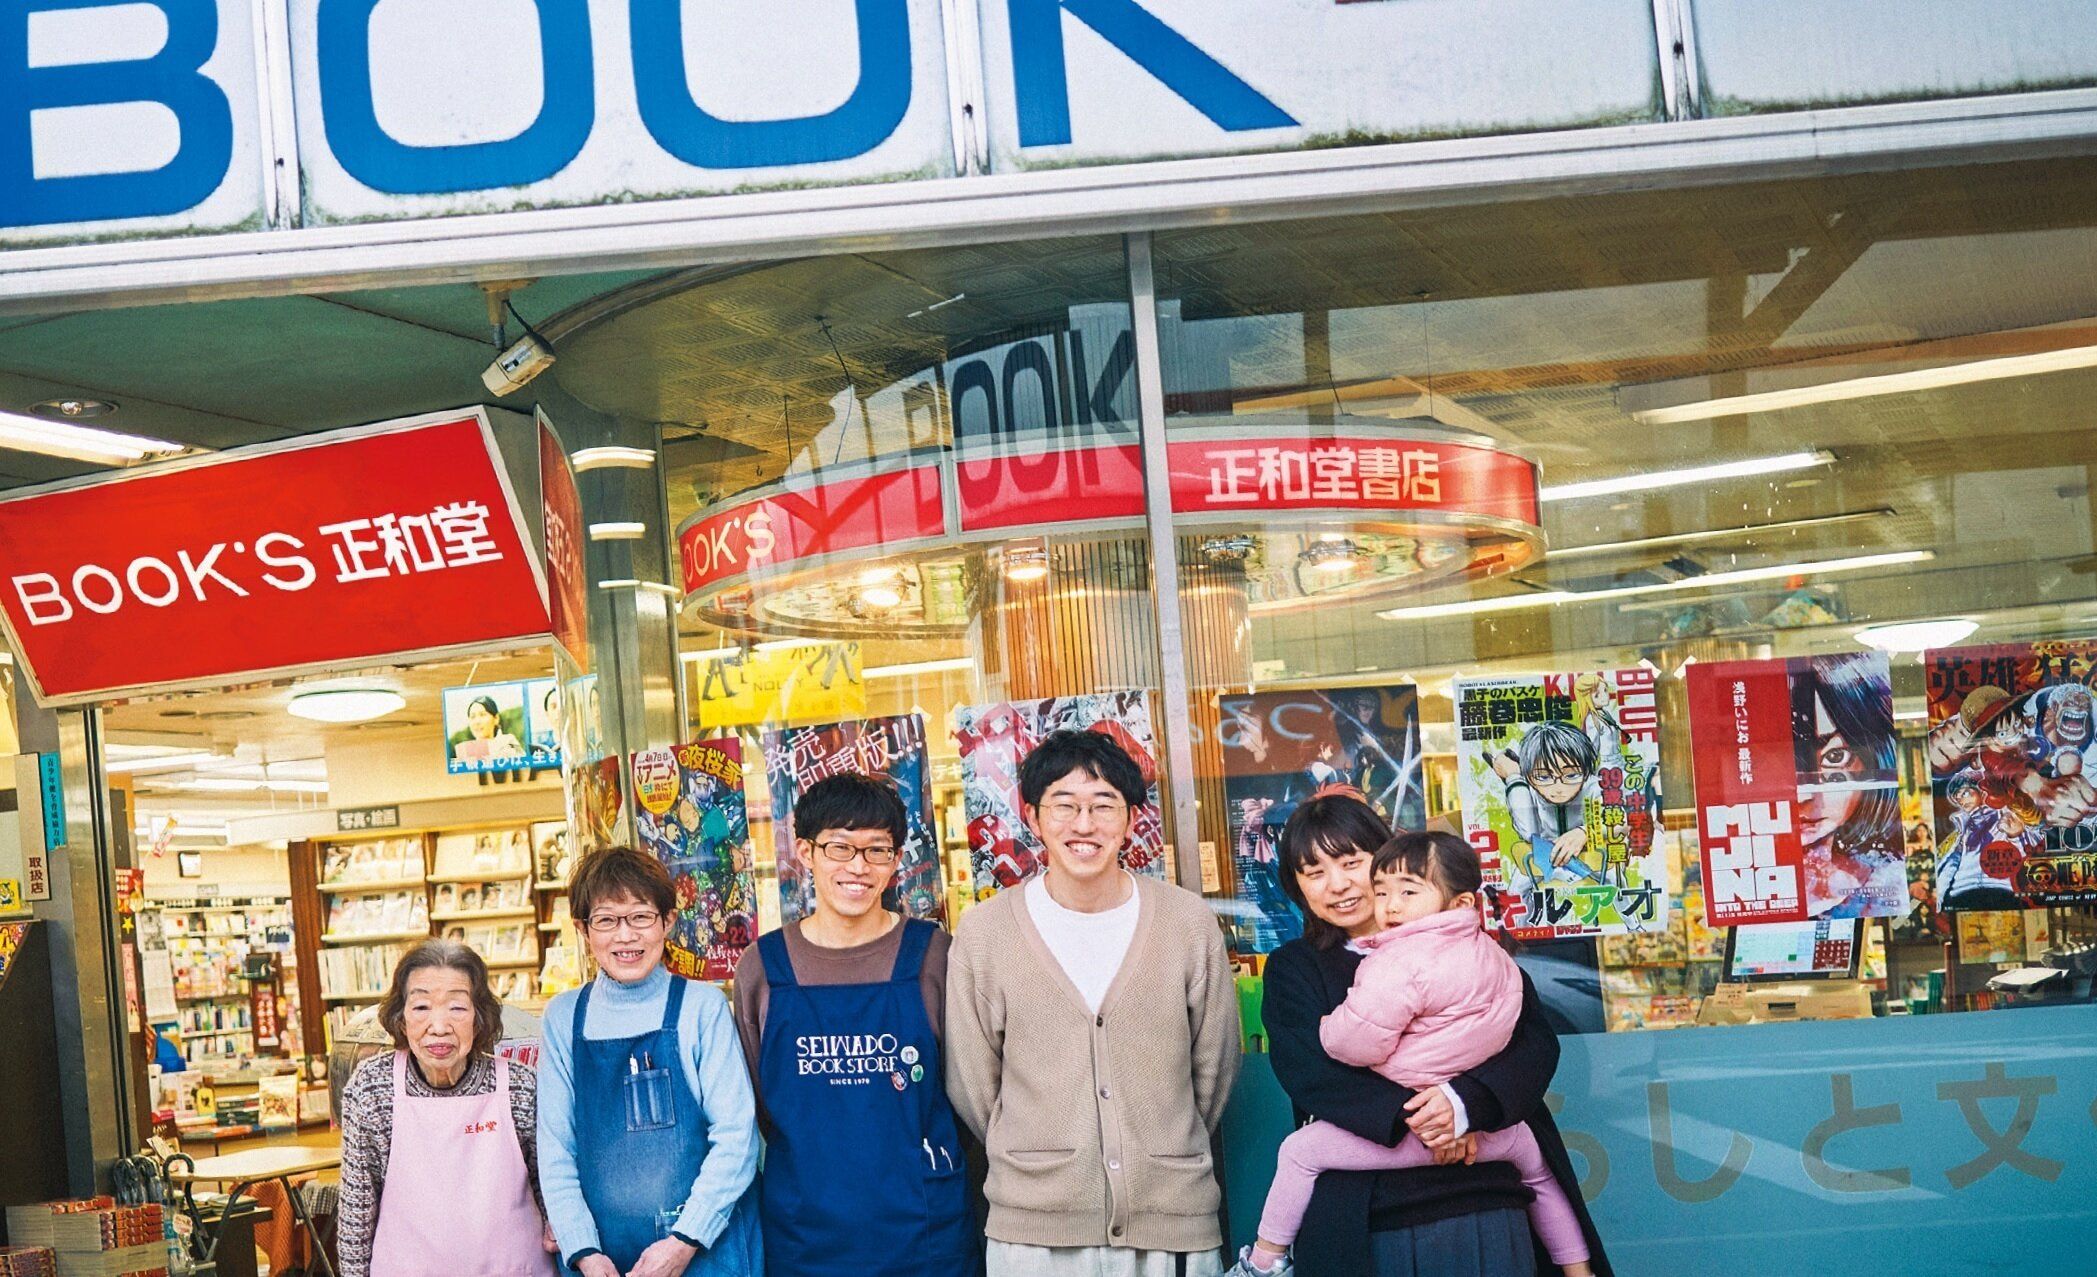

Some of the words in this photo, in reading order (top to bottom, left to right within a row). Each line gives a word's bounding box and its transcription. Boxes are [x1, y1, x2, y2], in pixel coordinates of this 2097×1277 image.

[1204, 446, 1441, 503] 正和堂書店
[12, 532, 316, 626] BOOK'S
[319, 500, 504, 583] 正和堂
[753, 678, 803, 692] NOLY
[1464, 685, 1540, 701] 黒子のバスケ
[1615, 668, 1660, 745] BLUE
[1732, 681, 1749, 744] 浅野いにお
[1738, 747, 1754, 785] 最新作
[1706, 800, 1792, 838] MU
[1709, 834, 1777, 870] JI
[28, 856, 44, 894] 取扱店
[1712, 865, 1798, 903] NA
[796, 1033, 898, 1057] SEIWADO
[798, 1058, 845, 1075] BOOK
[846, 1056, 898, 1074] STORE
[830, 1078, 852, 1086] SINCE
[854, 1078, 870, 1086] 1970
[465, 1121, 498, 1135] 正和堂
